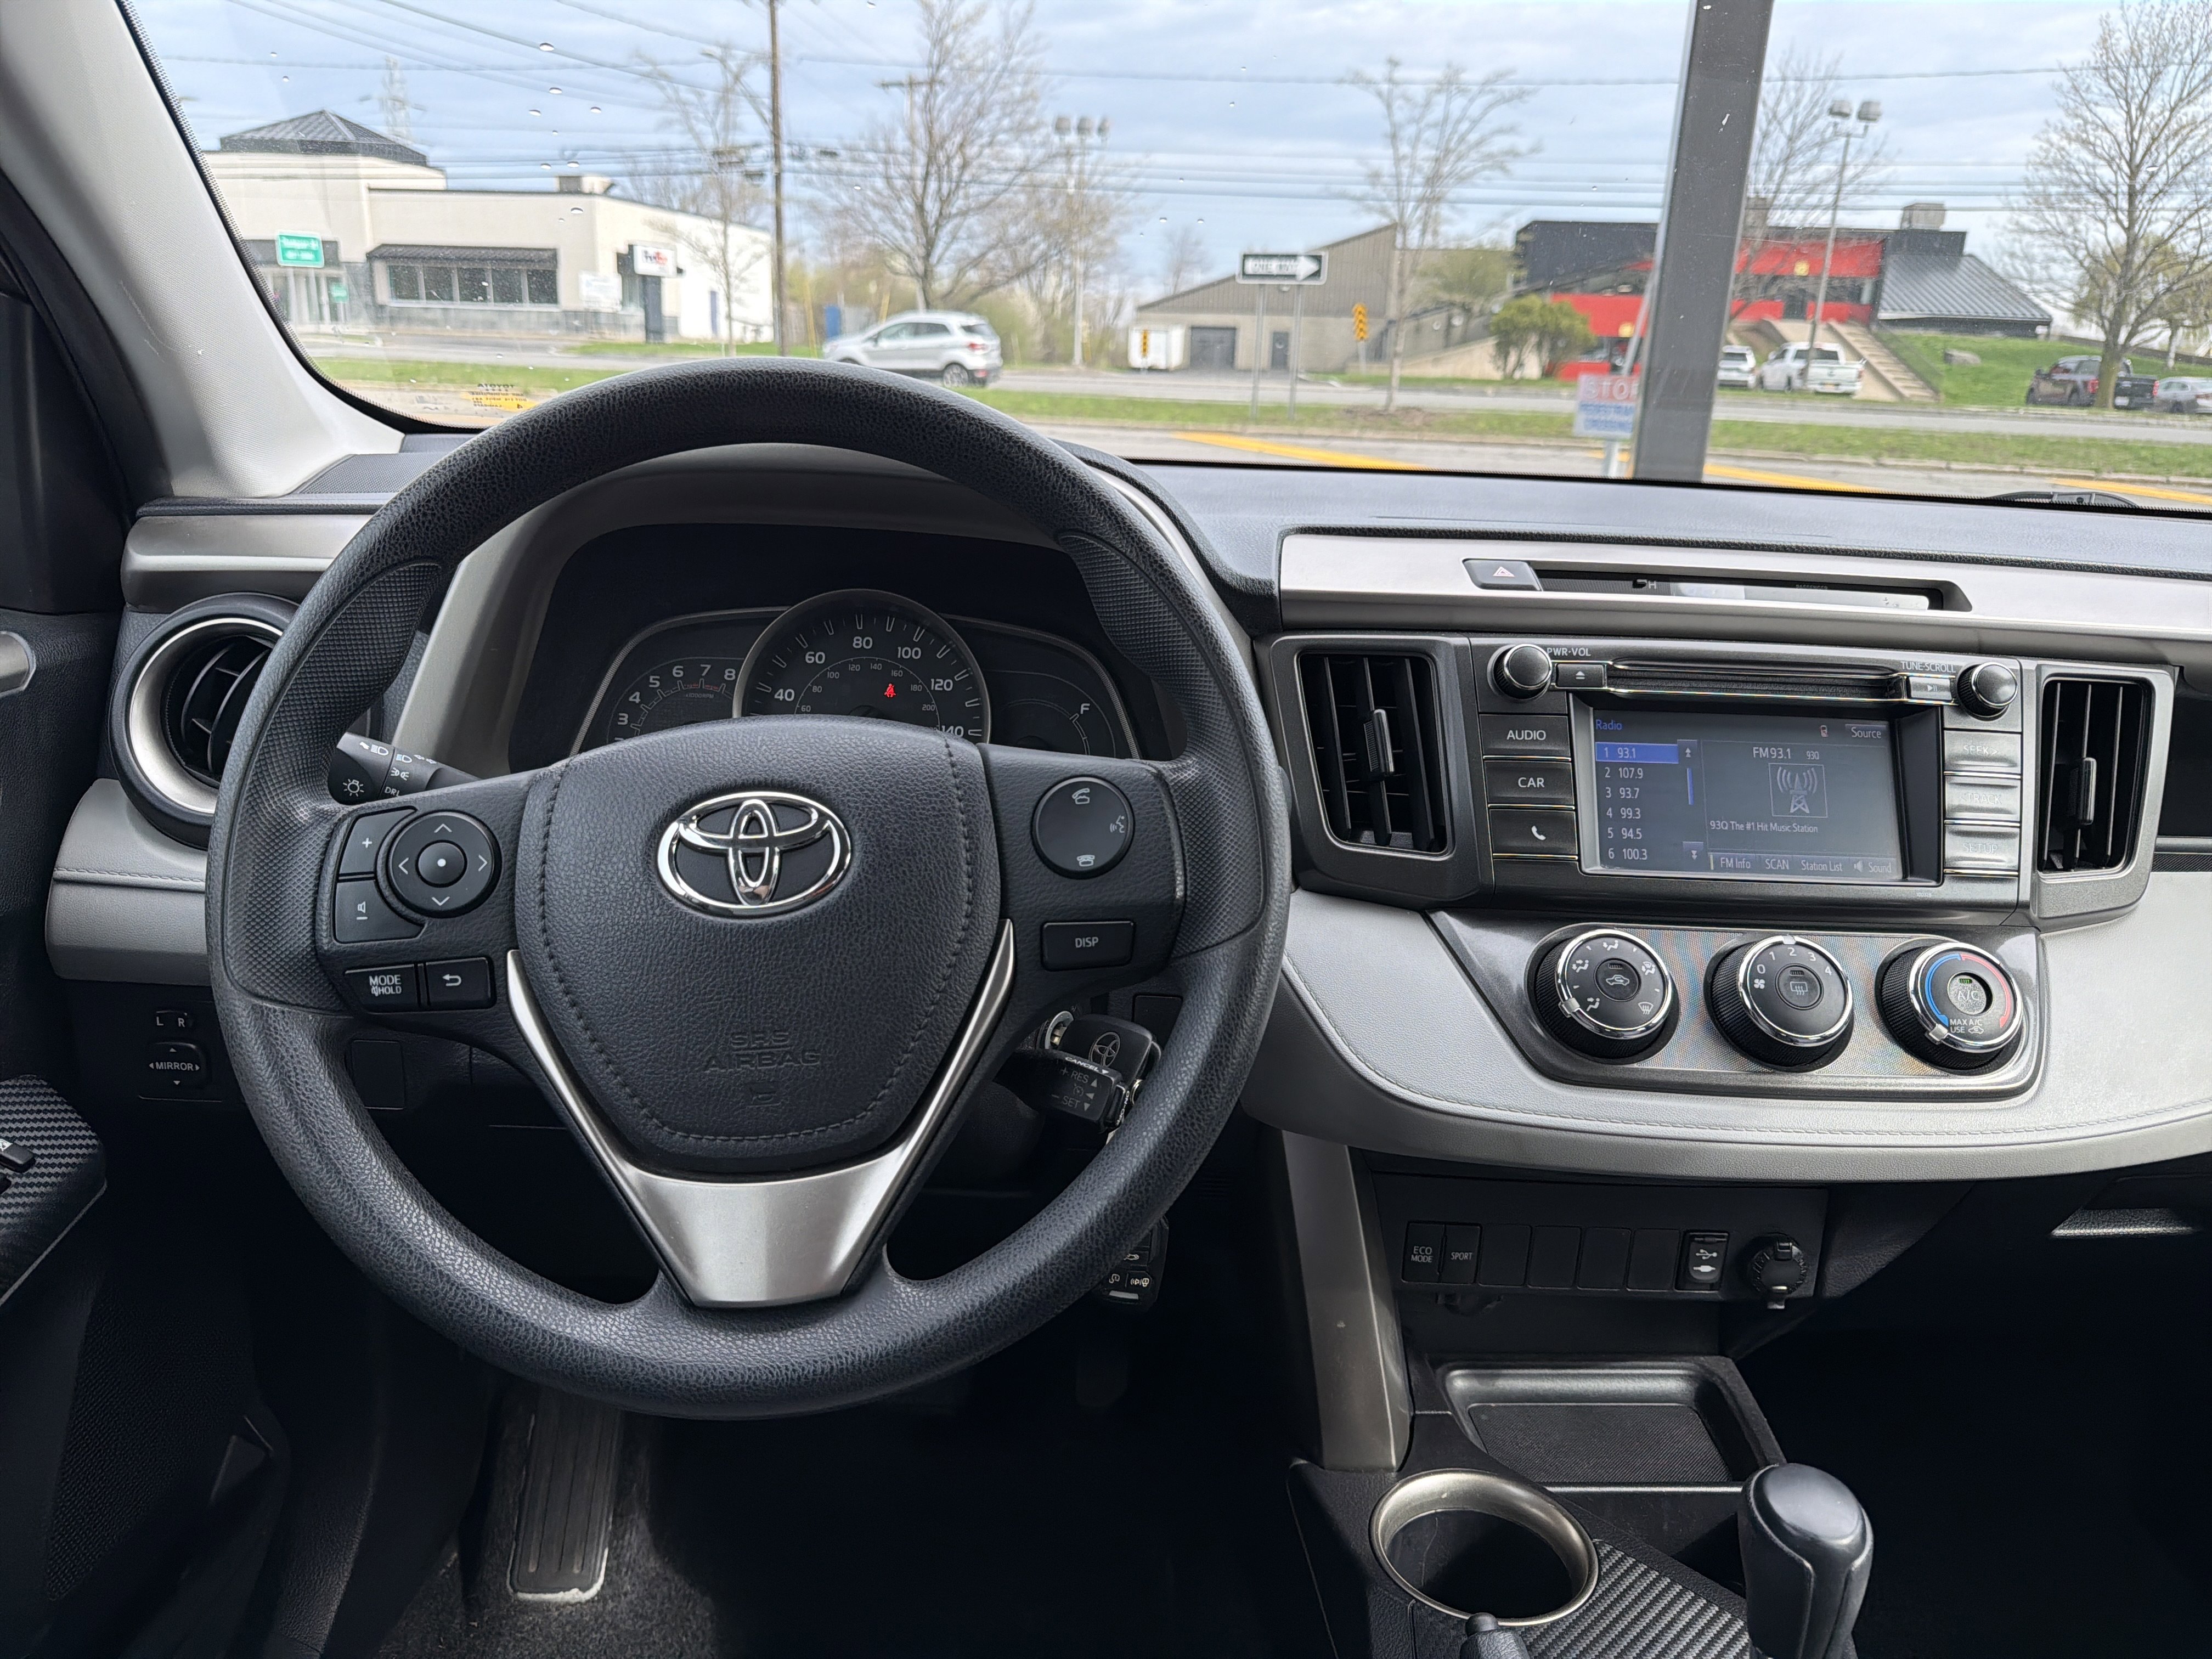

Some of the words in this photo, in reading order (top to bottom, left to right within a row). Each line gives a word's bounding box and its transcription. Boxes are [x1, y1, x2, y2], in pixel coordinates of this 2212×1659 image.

[853, 636, 873, 649] 80
[805, 651, 826, 664] 60
[898, 646, 922, 659] 100
[672, 665, 684, 678] 6
[700, 664, 712, 676] 7
[724, 668, 736, 681] 8
[649, 675, 660, 687] 5
[931, 678, 953, 691] 120
[629, 691, 641, 703] 4
[774, 689, 794, 702] 40
[1080, 703, 1090, 714] F
[617, 713, 629, 725] 3
[1595, 719, 1623, 731] Radio
[1506, 730, 1547, 741] AUDIO
[1851, 726, 1882, 739] Source
[1604, 747, 1609, 758] 1
[1617, 747, 1637, 759] 93.1
[1605, 767, 1611, 778] 2
[1618, 767, 1644, 779] 107.9
[1517, 777, 1545, 788] CAR
[385, 786, 401, 797] DRL
[1605, 787, 1612, 798] 3
[1619, 787, 1640, 799] 93.7
[1606, 807, 1613, 818] 4
[1620, 807, 1641, 819] 99.3
[1607, 827, 1614, 839] 5
[1621, 827, 1643, 839] 94.5
[1730, 821, 1744, 831] The
[1746, 822, 1755, 831] #1
[1757, 822, 1768, 832] Hit
[1770, 823, 1791, 832] Music
[1792, 823, 1818, 833] Station
[1608, 848, 1615, 859] 6
[1622, 848, 1647, 860] 100.3
[1720, 857, 1734, 868] FM
[1735, 857, 1751, 869] Info
[1765, 859, 1790, 870] SCAN
[1801, 860, 1827, 871] Station
[1829, 861, 1843, 872] List
[1868, 862, 1892, 873] Sound
[1075, 936, 1099, 948] DISP
[1769, 951, 1775, 960] 1
[1787, 947, 1797, 956] 2
[1808, 952, 1816, 961] 3
[1757, 964, 1765, 974] 0
[1825, 966, 1832, 975] 4
[369, 974, 402, 986] MODE
[379, 986, 402, 995] HOLD
[1957, 989, 1980, 1001] A/C
[156, 1017, 164, 1026] L
[178, 1018, 185, 1027] R
[730, 1031, 790, 1048] SRS
[155, 1062, 194, 1071] MIRROR
[704, 1050, 821, 1074] AIRBAG
[1065, 1057, 1099, 1073] CANCEL
[1413, 1245, 1433, 1255] ECO
[1450, 1251, 1473, 1261] SPORT
[1410, 1255, 1434, 1263] MODE
